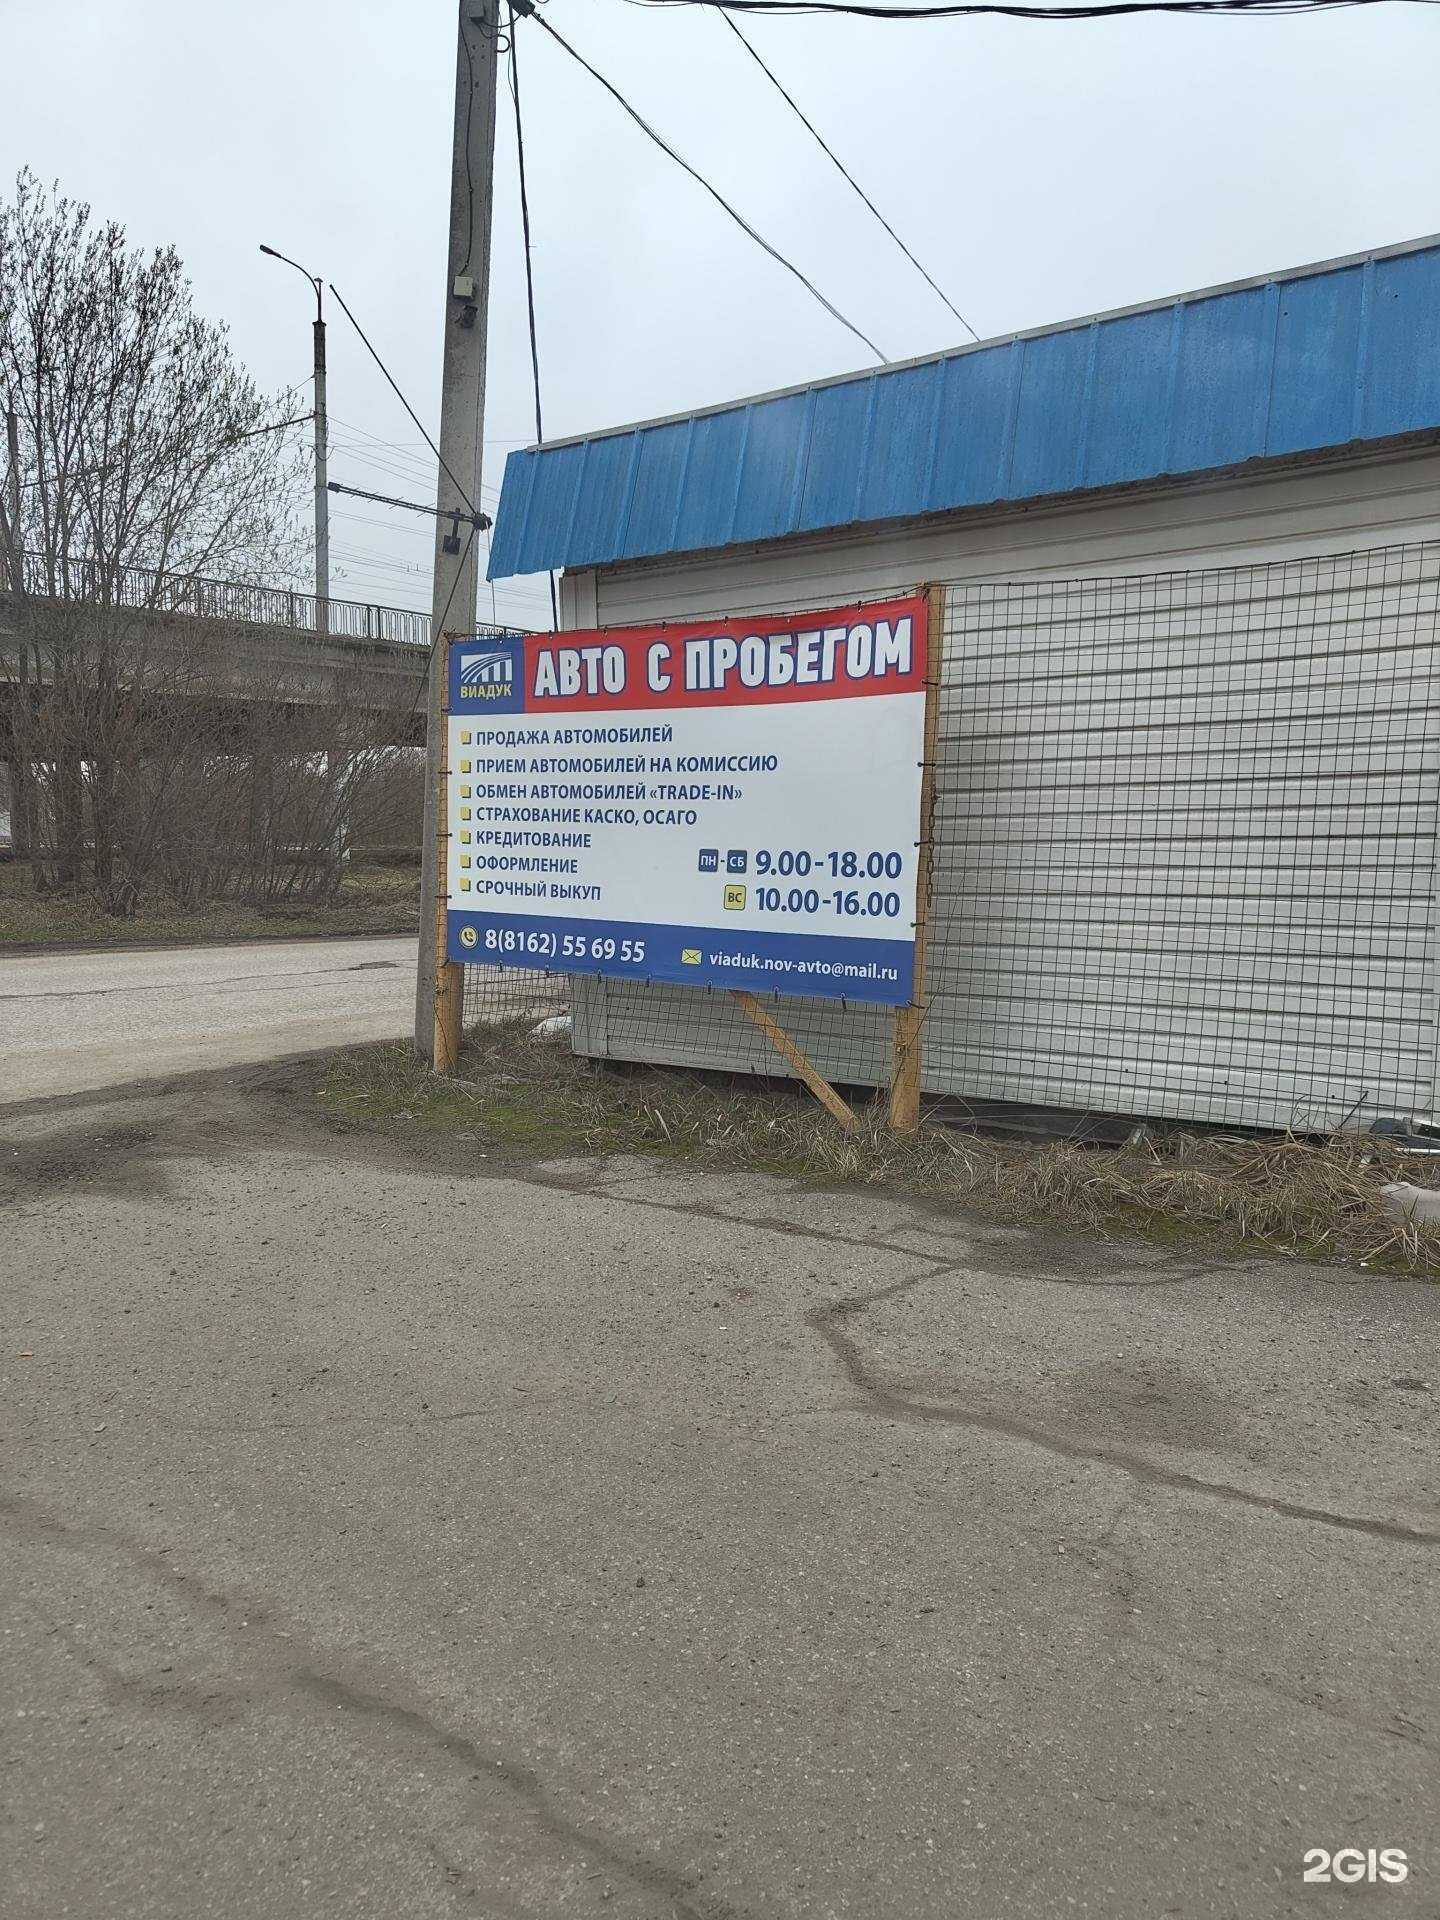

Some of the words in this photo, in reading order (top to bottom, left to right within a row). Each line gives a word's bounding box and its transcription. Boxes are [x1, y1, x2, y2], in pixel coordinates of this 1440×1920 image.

[534, 644, 627, 699] АВТО
[646, 642, 673, 692] С
[684, 616, 913, 691] ПРОБЕГОМ
[460, 684, 512, 700] ВИАДУК
[477, 729, 549, 747] ПРОДАЖА
[554, 724, 673, 744] АВТОМОБИЛЕЙ
[477, 758, 526, 774] ПРИЕМ
[530, 755, 646, 773] АВТОМОБИЛЕЙ
[650, 757, 672, 772] НА
[677, 755, 778, 772] КОМИССИЮ
[477, 784, 527, 800] ОБМЕН
[530, 782, 646, 800] АВТОМОБИЛЕЙ
[650, 785, 742, 801] «TRADE-IN»
[477, 806, 581, 823] СТРАХОВАНИЕ
[585, 808, 639, 826] КАСКО,
[644, 809, 697, 825] ОСАГО
[477, 831, 591, 848] КРЕДИТОВАНИЕ
[477, 855, 578, 874] ОФОРМЛЕНИЕ
[477, 878, 547, 897] СРОЧНЫЙ
[550, 884, 601, 900] ВЫКУП
[728, 892, 742, 904] ВС
[485, 928, 557, 958] 8(8162)
[563, 935, 586, 957] 55
[592, 937, 615, 960] 69
[621, 940, 645, 963] 55
[709, 951, 897, 981] viaduk.nov-avto@mail.ru
